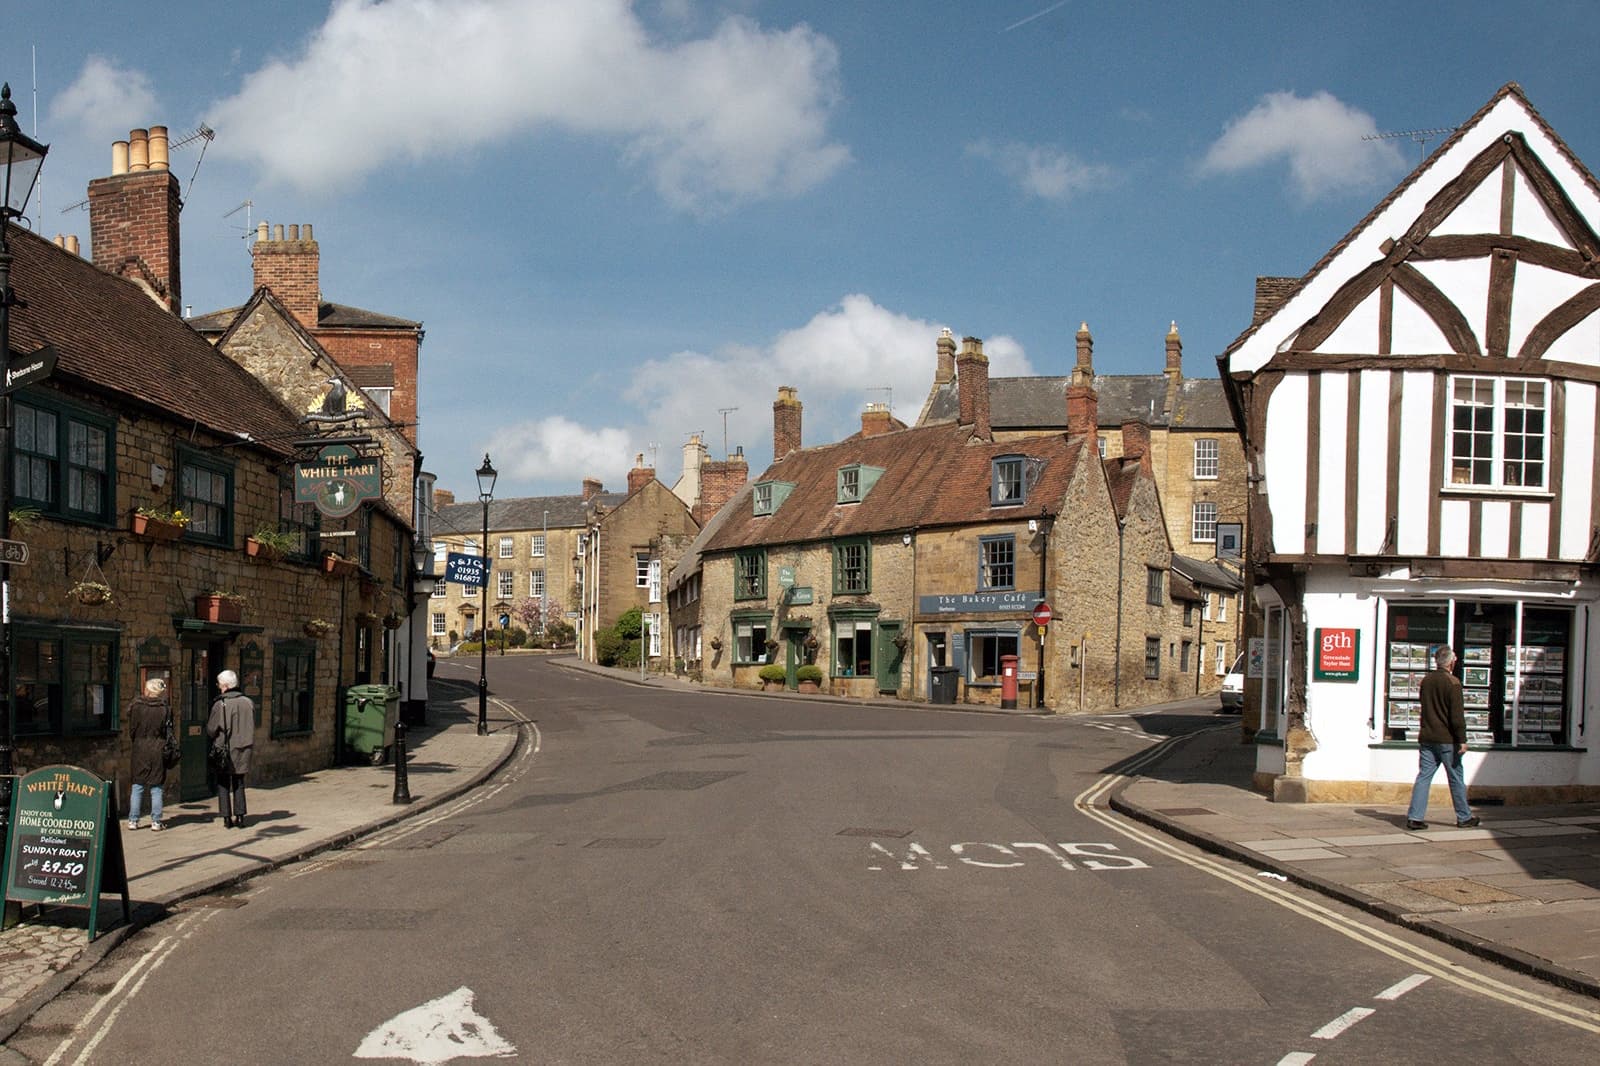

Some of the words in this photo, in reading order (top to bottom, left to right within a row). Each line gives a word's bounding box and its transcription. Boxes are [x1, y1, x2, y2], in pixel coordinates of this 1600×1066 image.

[325, 454, 349, 465] THE
[300, 466, 338, 478] WHITE
[343, 464, 376, 476] HART
[449, 560, 456, 568] P
[457, 566, 480, 575] 01935
[454, 573, 481, 583] 816877
[939, 596, 956, 604] The
[962, 595, 996, 604] Bakery
[1003, 593, 1026, 602] Café
[1323, 631, 1352, 652] gth
[54, 773, 70, 782] THE
[27, 781, 64, 793] WHITE
[66, 782, 96, 797] HART
[19, 816, 42, 827] HOME
[42, 818, 73, 829] COOKED
[73, 820, 95, 831] FOOD
[22, 844, 58, 856] SUNDAY
[58, 849, 88, 858] ROAST
[41, 860, 84, 876] £9.50
[28, 875, 48, 886] Served
